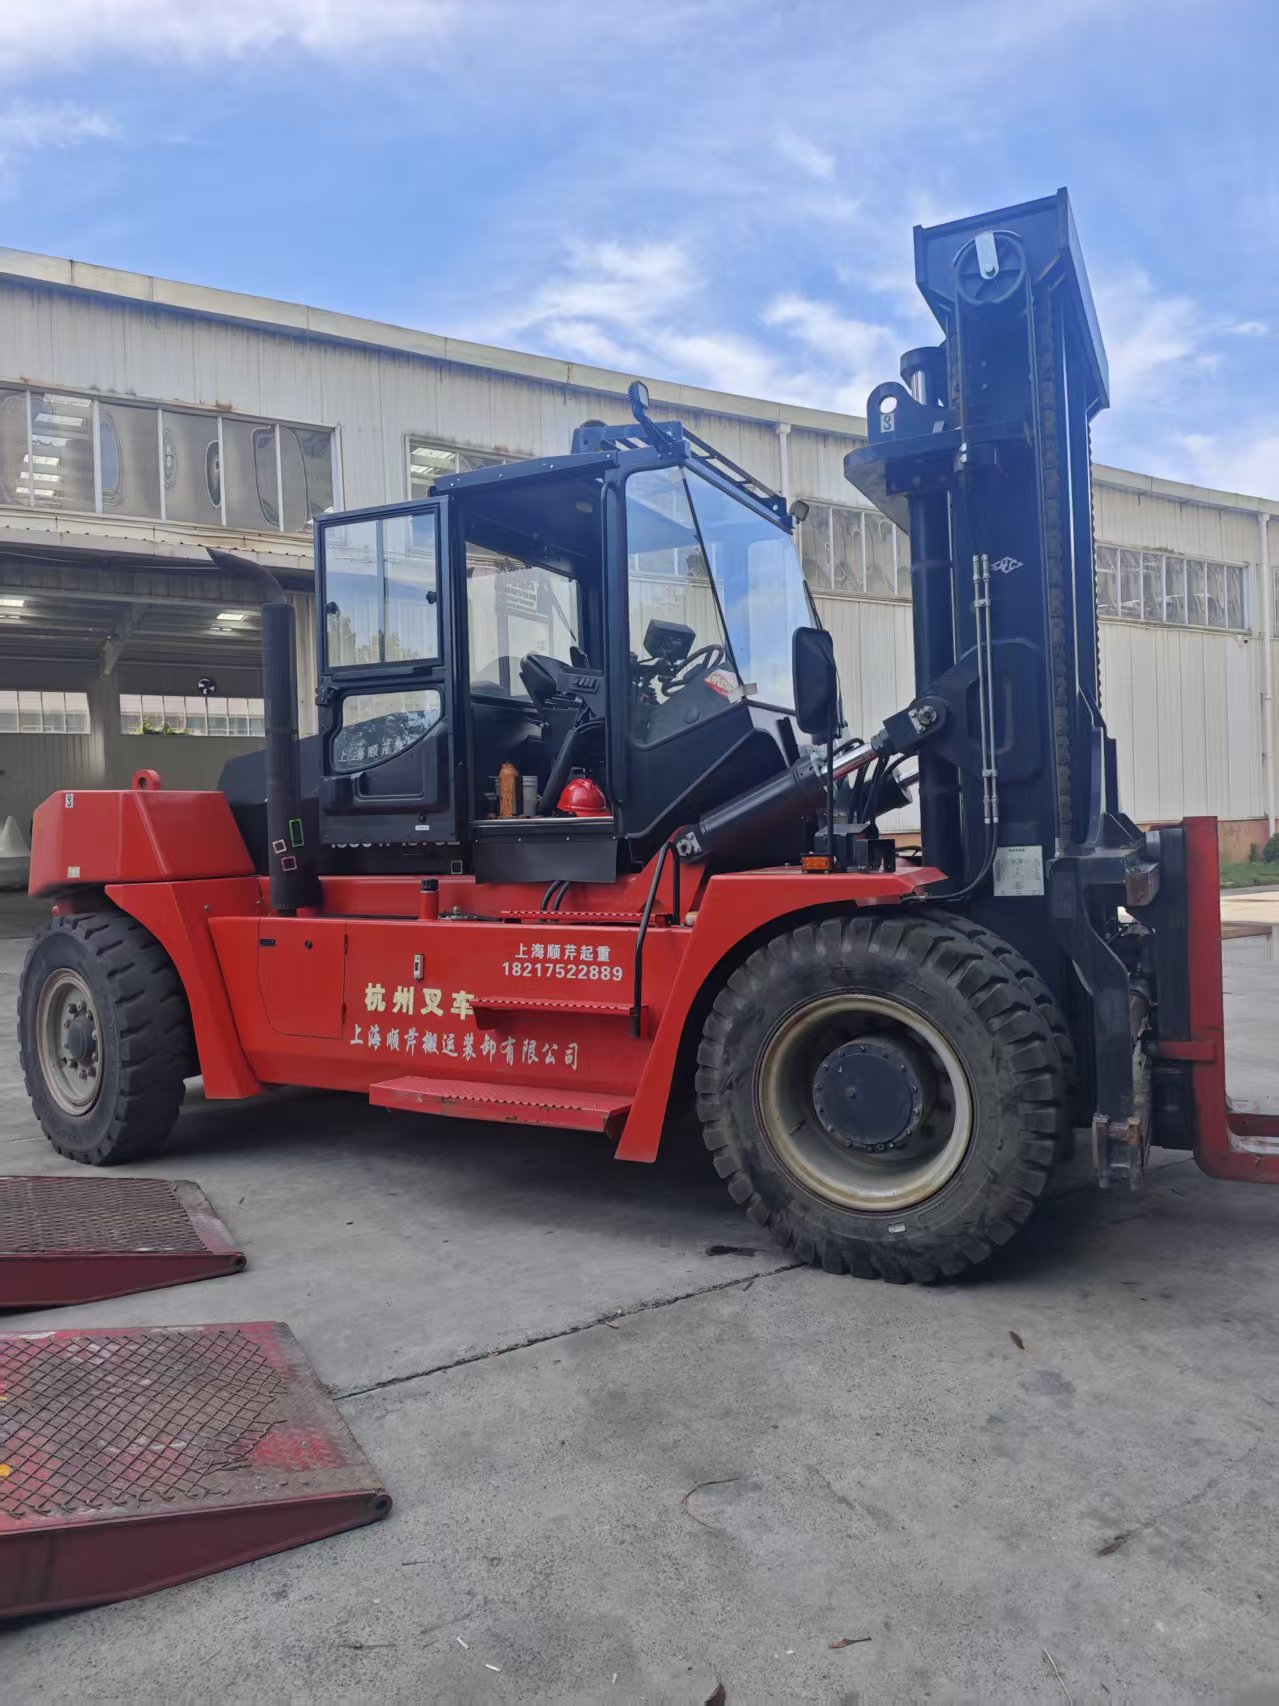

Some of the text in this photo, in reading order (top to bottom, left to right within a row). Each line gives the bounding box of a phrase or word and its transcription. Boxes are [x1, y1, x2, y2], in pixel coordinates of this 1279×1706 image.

[515, 943, 611, 962] 上海顺芹起重
[502, 961, 623, 981] 18217522889
[364, 982, 475, 1020] 杭州叉车
[350, 1023, 579, 1071] 上海顺芹搬运装卸有限公司
